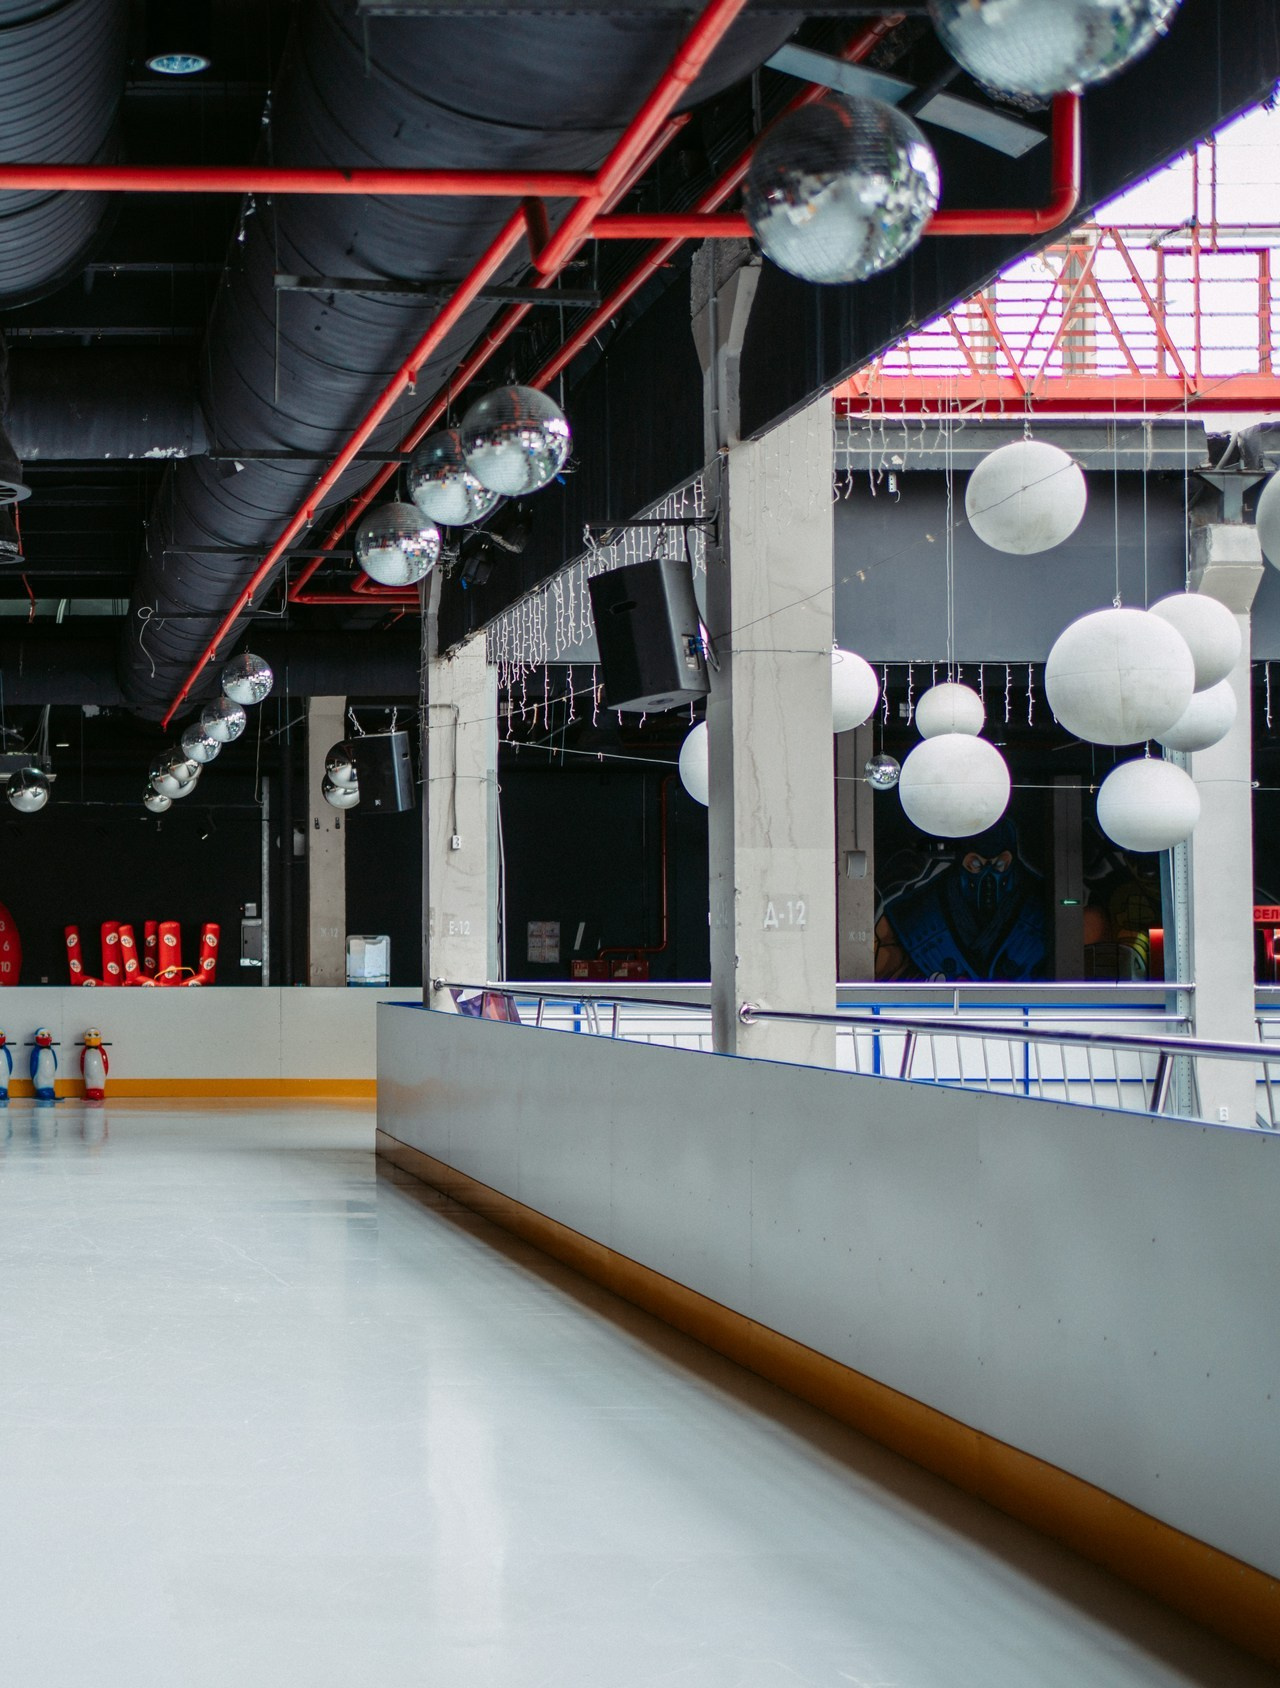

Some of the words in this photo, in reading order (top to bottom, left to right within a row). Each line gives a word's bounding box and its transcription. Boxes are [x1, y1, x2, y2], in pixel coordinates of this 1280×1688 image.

[1254, 909, 1280, 920] СЕЛ
[3, 943, 10, 952] 6
[0, 961, 11, 973] 10
